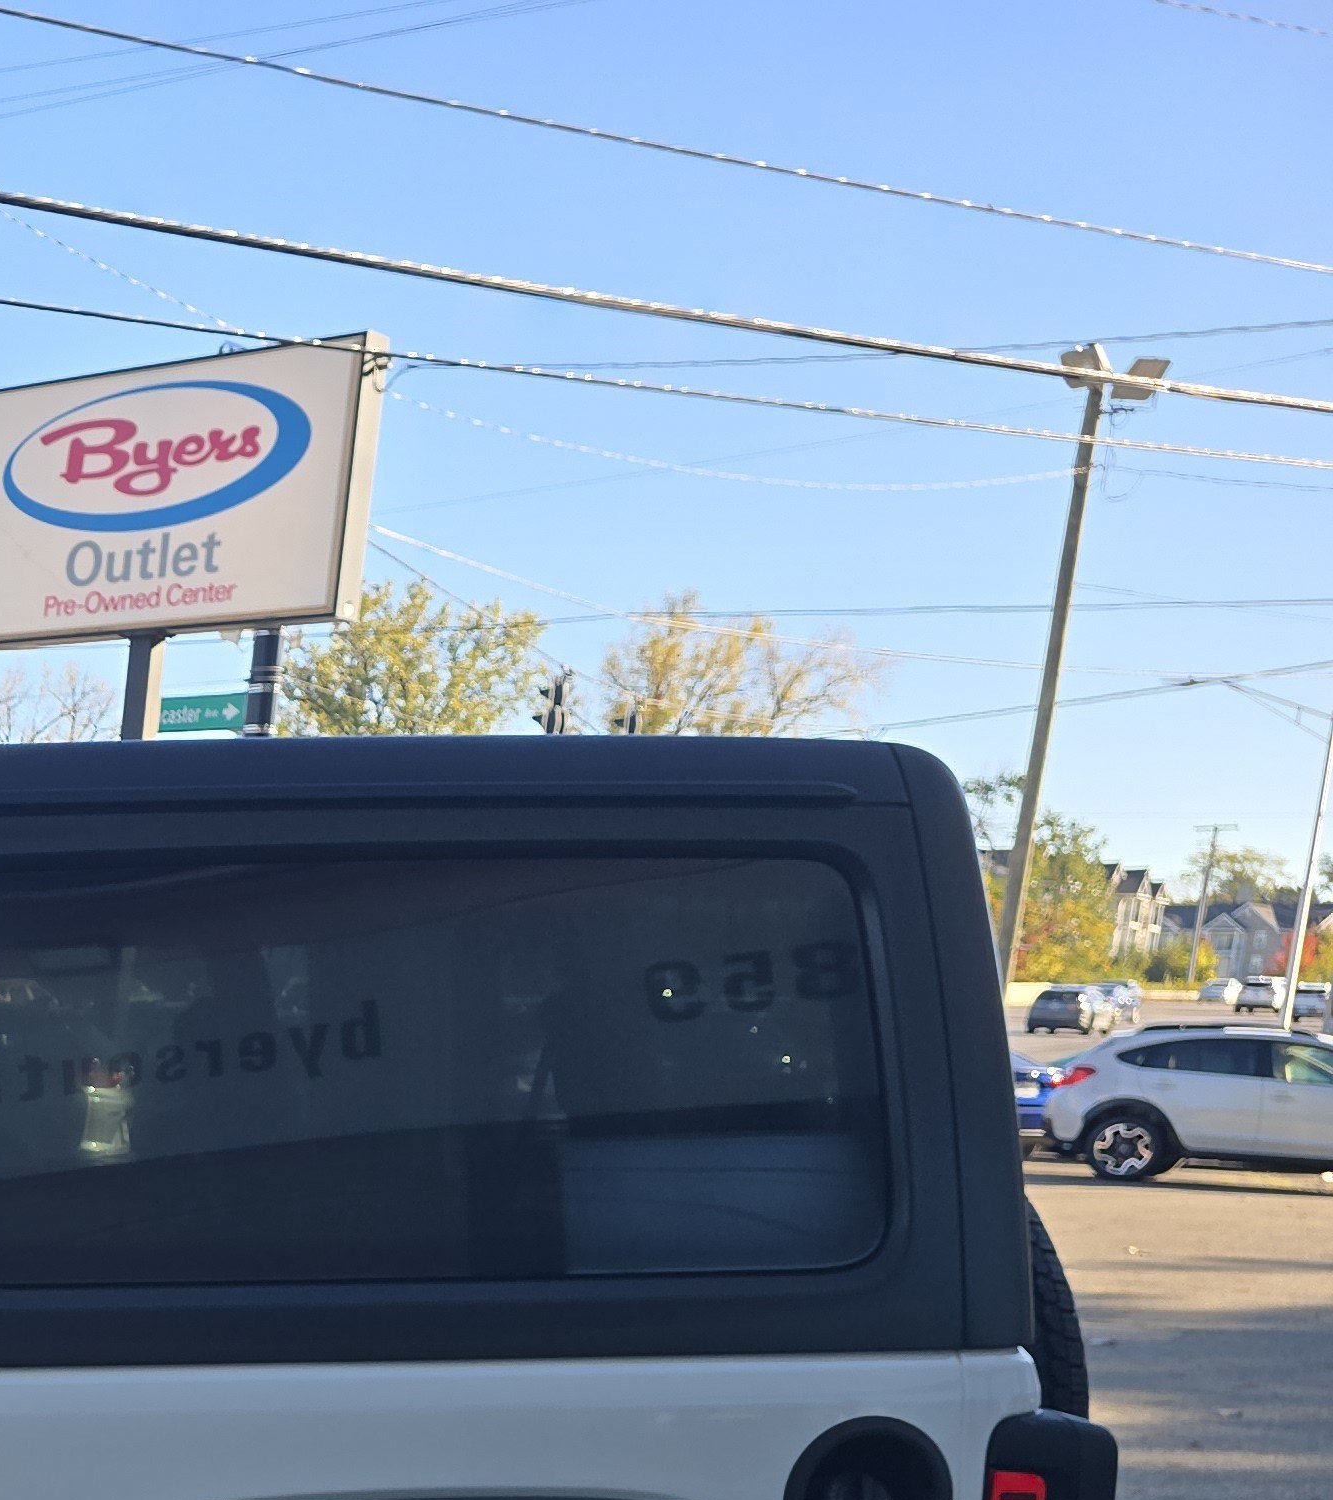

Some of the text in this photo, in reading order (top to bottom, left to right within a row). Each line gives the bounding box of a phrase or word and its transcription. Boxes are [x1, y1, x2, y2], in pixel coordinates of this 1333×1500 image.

[40, 419, 260, 496] Byers
[65, 532, 222, 587] Outlet
[43, 582, 237, 618] Pre-Owned Center
